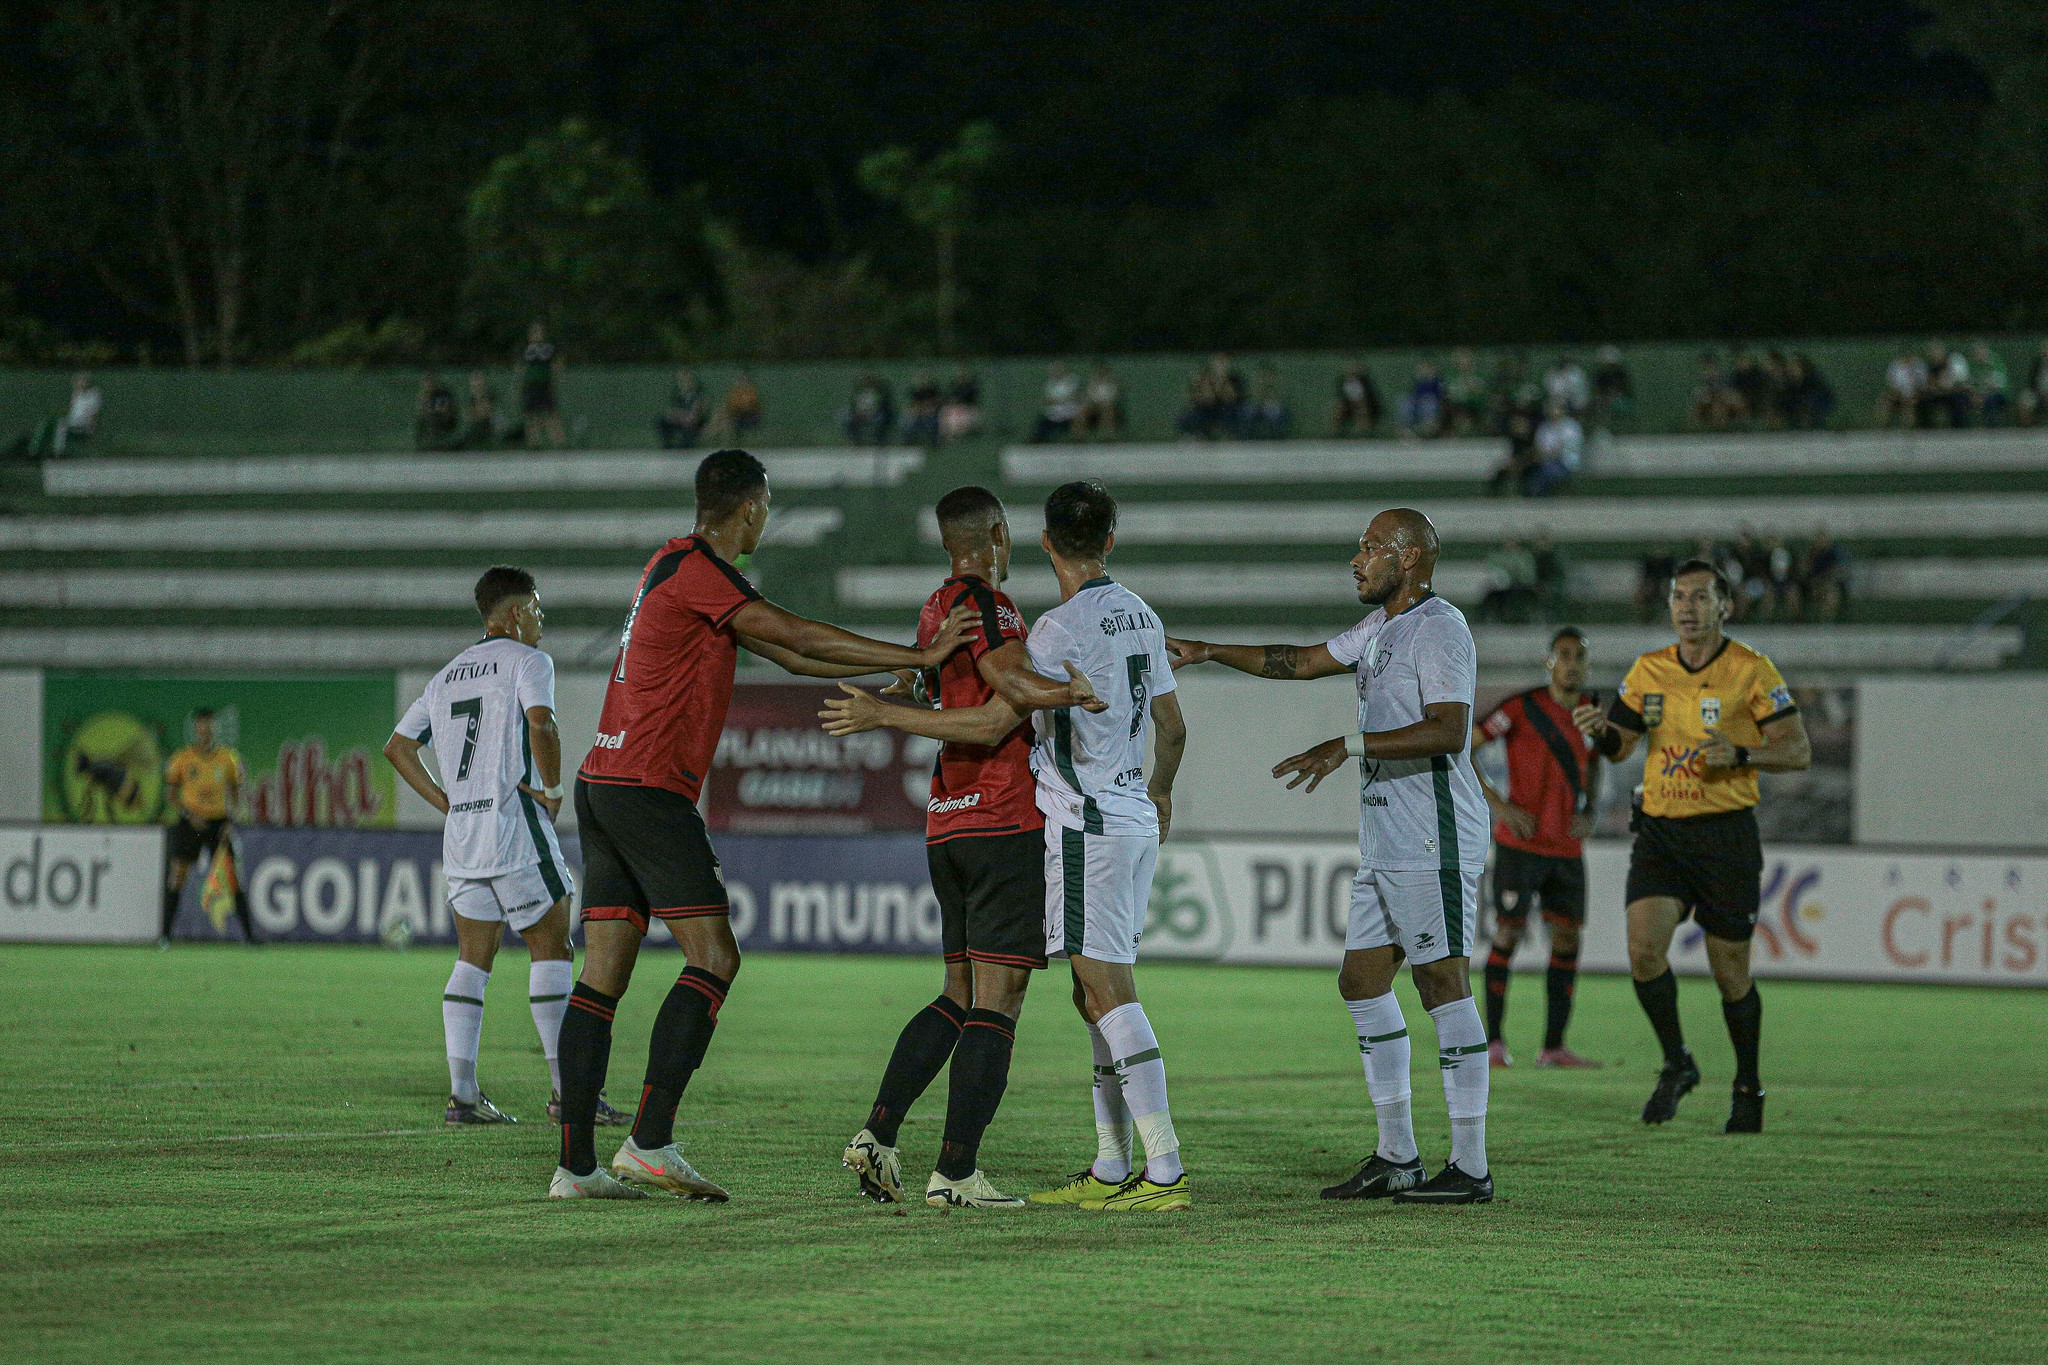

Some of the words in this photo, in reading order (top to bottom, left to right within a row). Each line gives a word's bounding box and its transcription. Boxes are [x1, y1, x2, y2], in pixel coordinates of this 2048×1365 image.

[1115, 612, 1154, 633] ITÁLIA
[1126, 653, 1151, 741] 5
[451, 697, 482, 782] 7
[4, 837, 110, 908] dor
[1883, 896, 2048, 972] Cris
